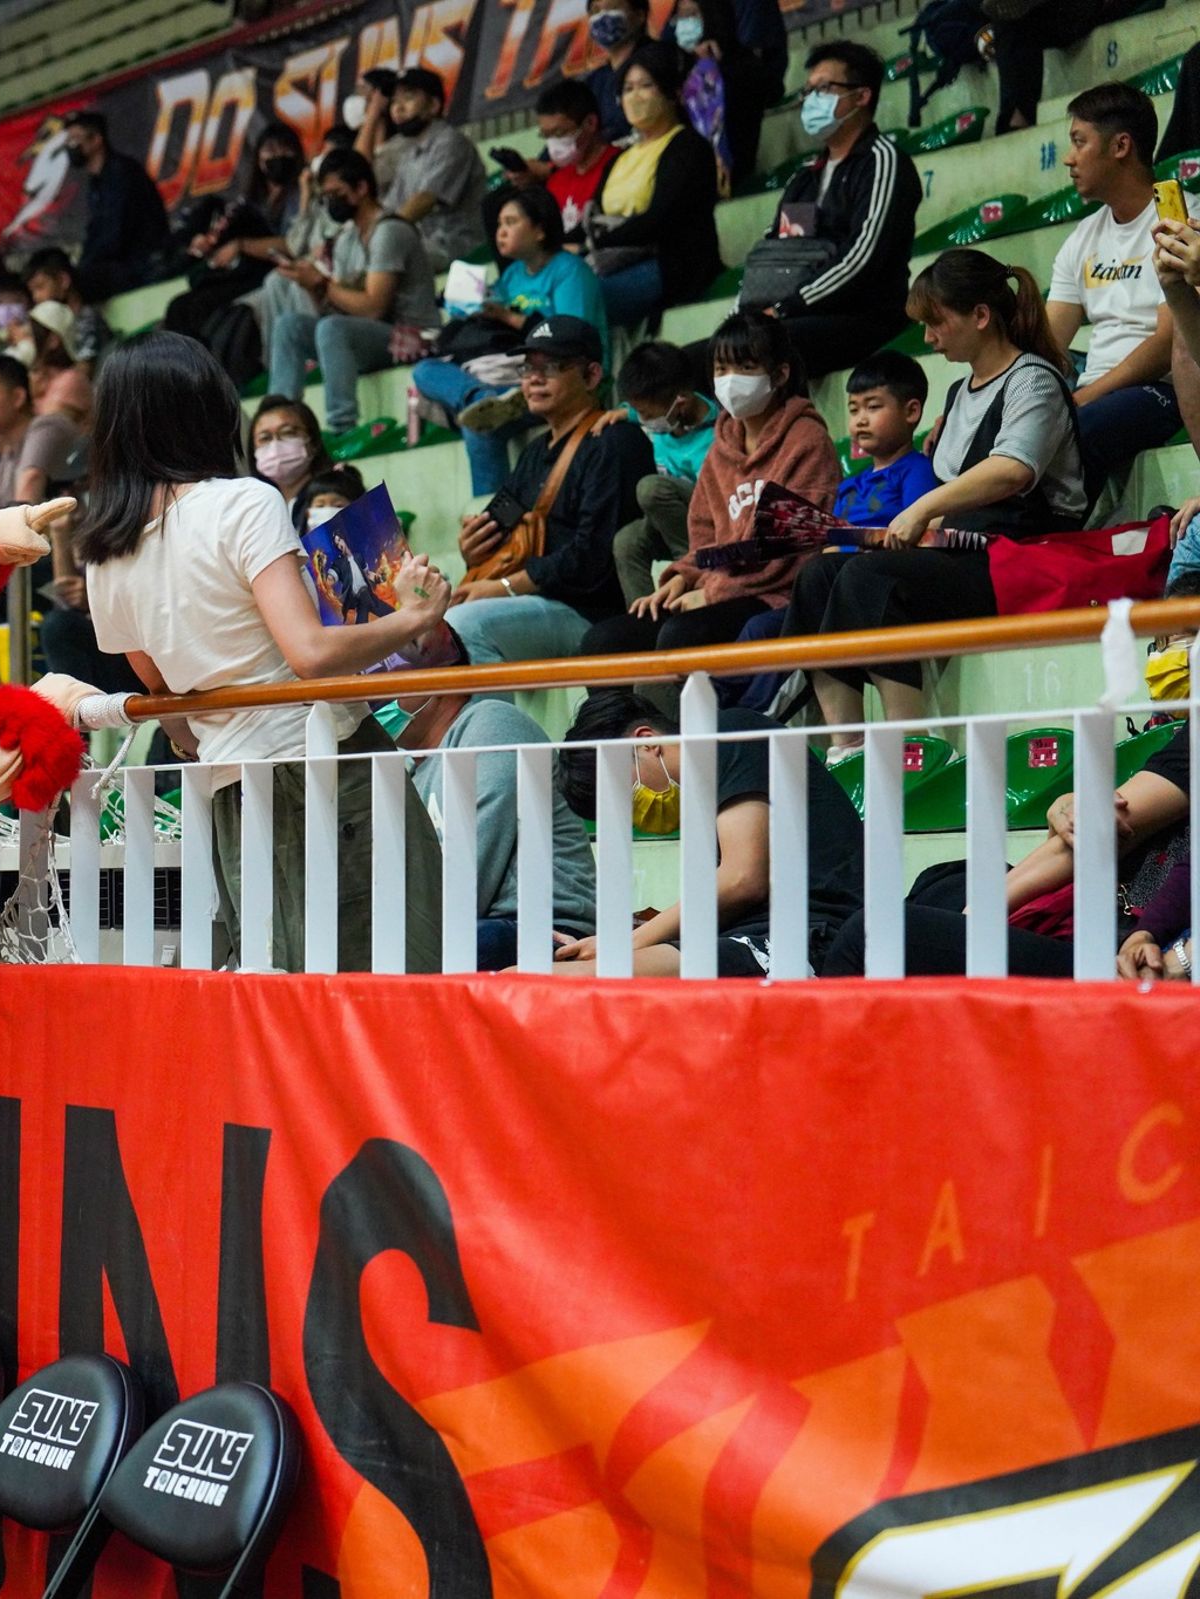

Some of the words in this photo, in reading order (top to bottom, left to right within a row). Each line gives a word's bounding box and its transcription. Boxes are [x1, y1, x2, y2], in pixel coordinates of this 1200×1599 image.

[1107, 40, 1118, 68] 8
[146, 66, 258, 212] DO
[8, 1388, 100, 1446] SUNS
[0, 1433, 76, 1471] TAICHUNG
[153, 1418, 255, 1481] SUNS
[143, 1466, 229, 1507] TAICHUNG
